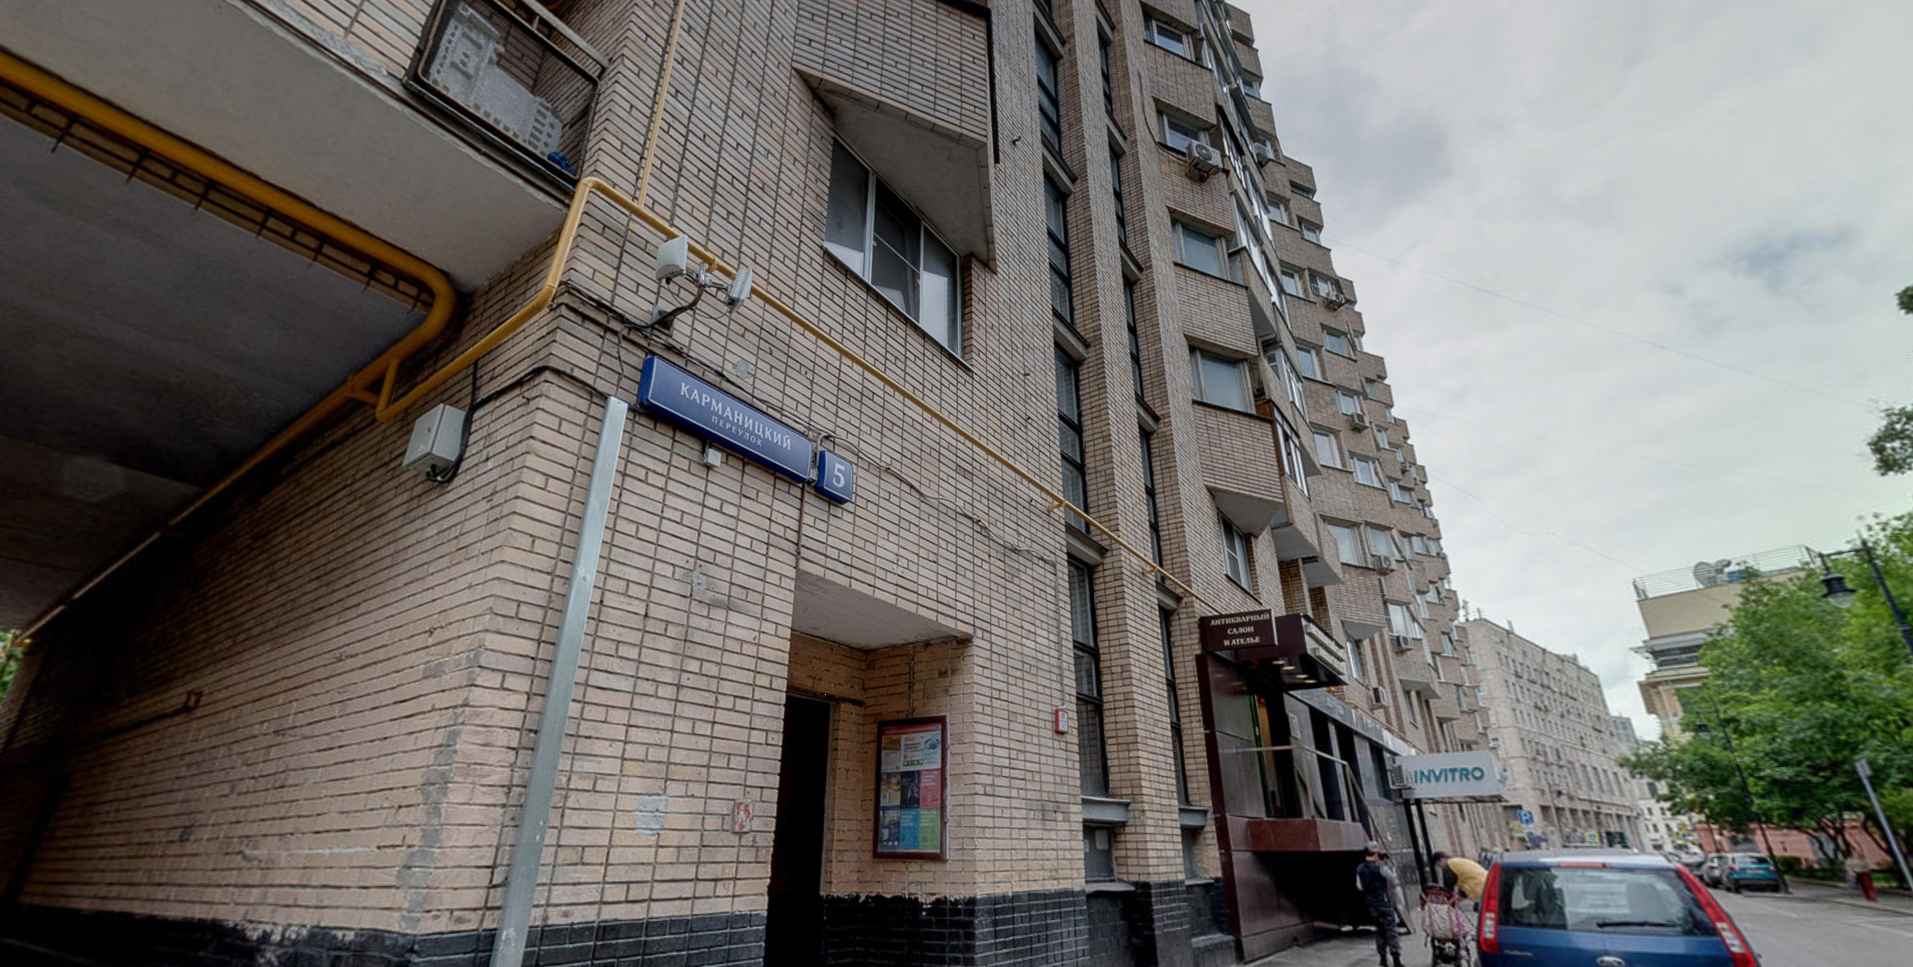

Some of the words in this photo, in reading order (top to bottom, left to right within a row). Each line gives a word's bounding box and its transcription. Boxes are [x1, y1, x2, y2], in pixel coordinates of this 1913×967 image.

[680, 382, 792, 450] КАРМАНИЦКИЙ
[711, 415, 763, 448] ПЕРЕУЛОК
[832, 463, 846, 488] 5
[1210, 613, 1270, 625] АНТИКВАРНЫЙ
[1227, 626, 1254, 635] САЛОН
[1414, 767, 1485, 784] INVITRO
